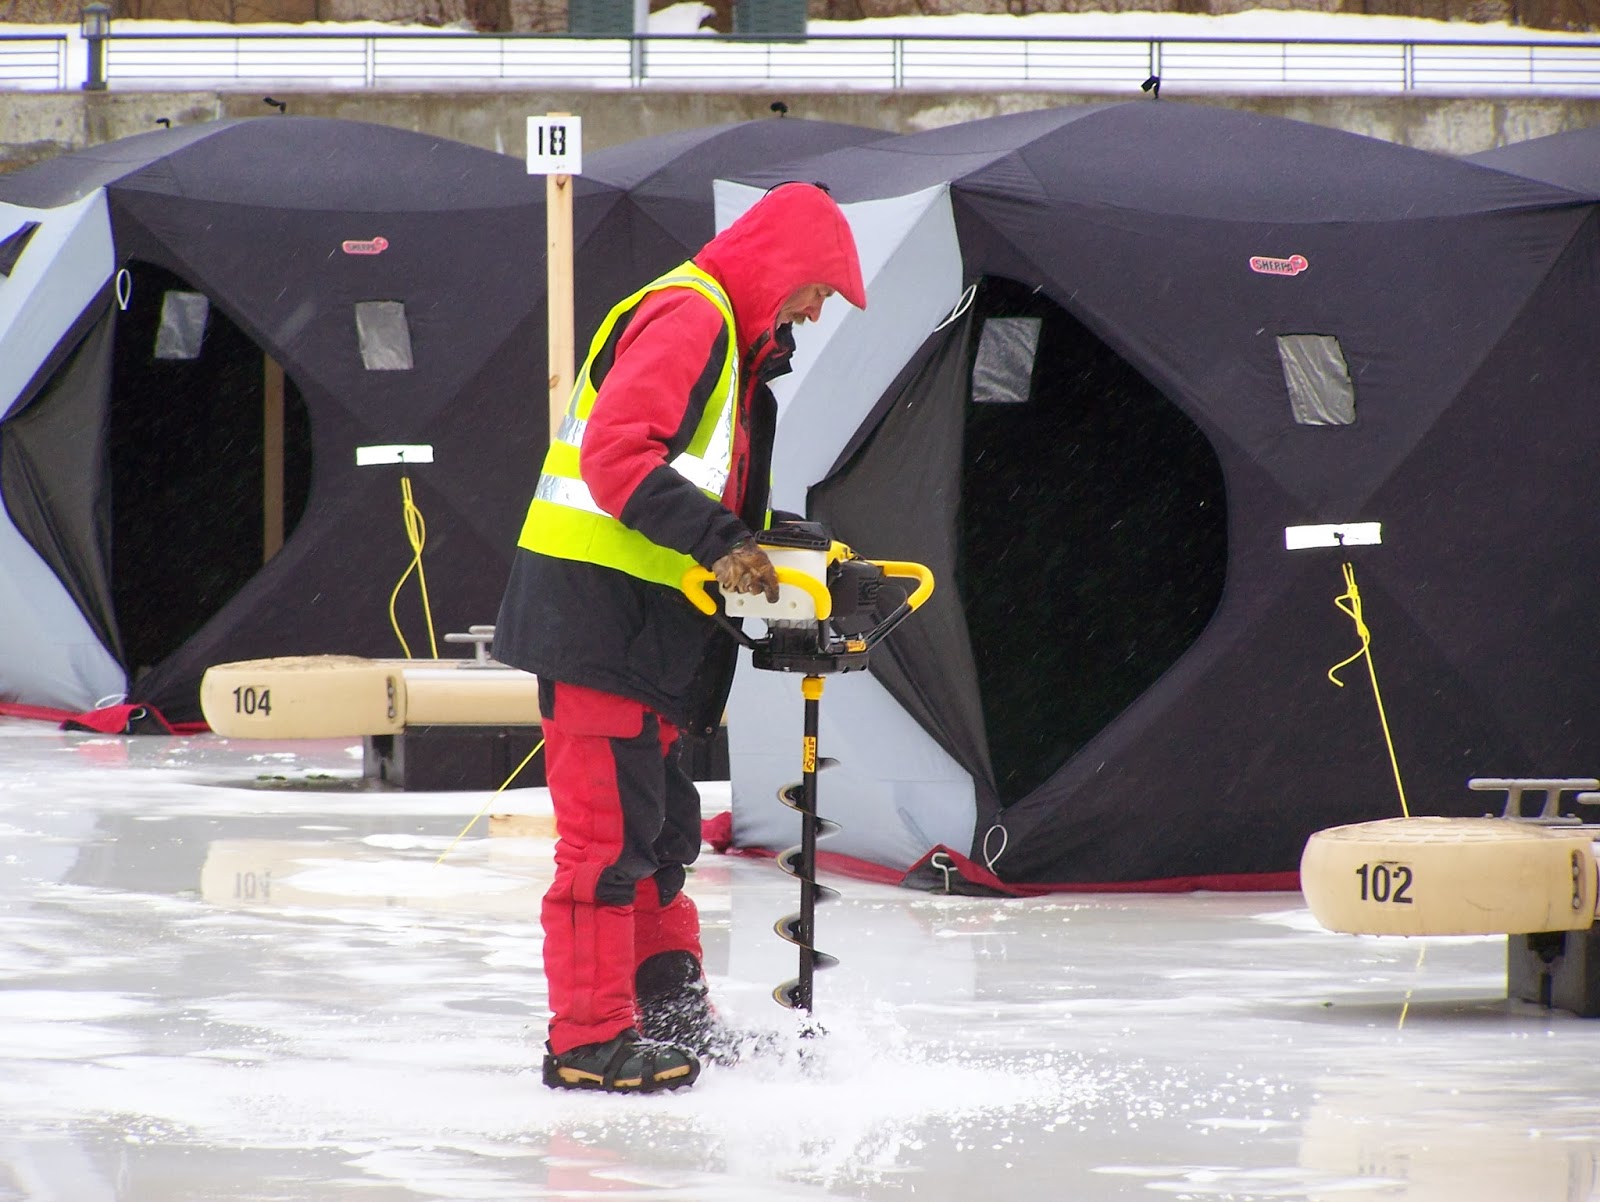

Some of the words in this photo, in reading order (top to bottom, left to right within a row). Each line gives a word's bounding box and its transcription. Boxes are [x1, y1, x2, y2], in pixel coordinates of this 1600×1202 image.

[538, 125, 566, 156] 18
[1255, 259, 1294, 272] SHERPA
[232, 685, 272, 717] 104
[1355, 863, 1414, 904] 102
